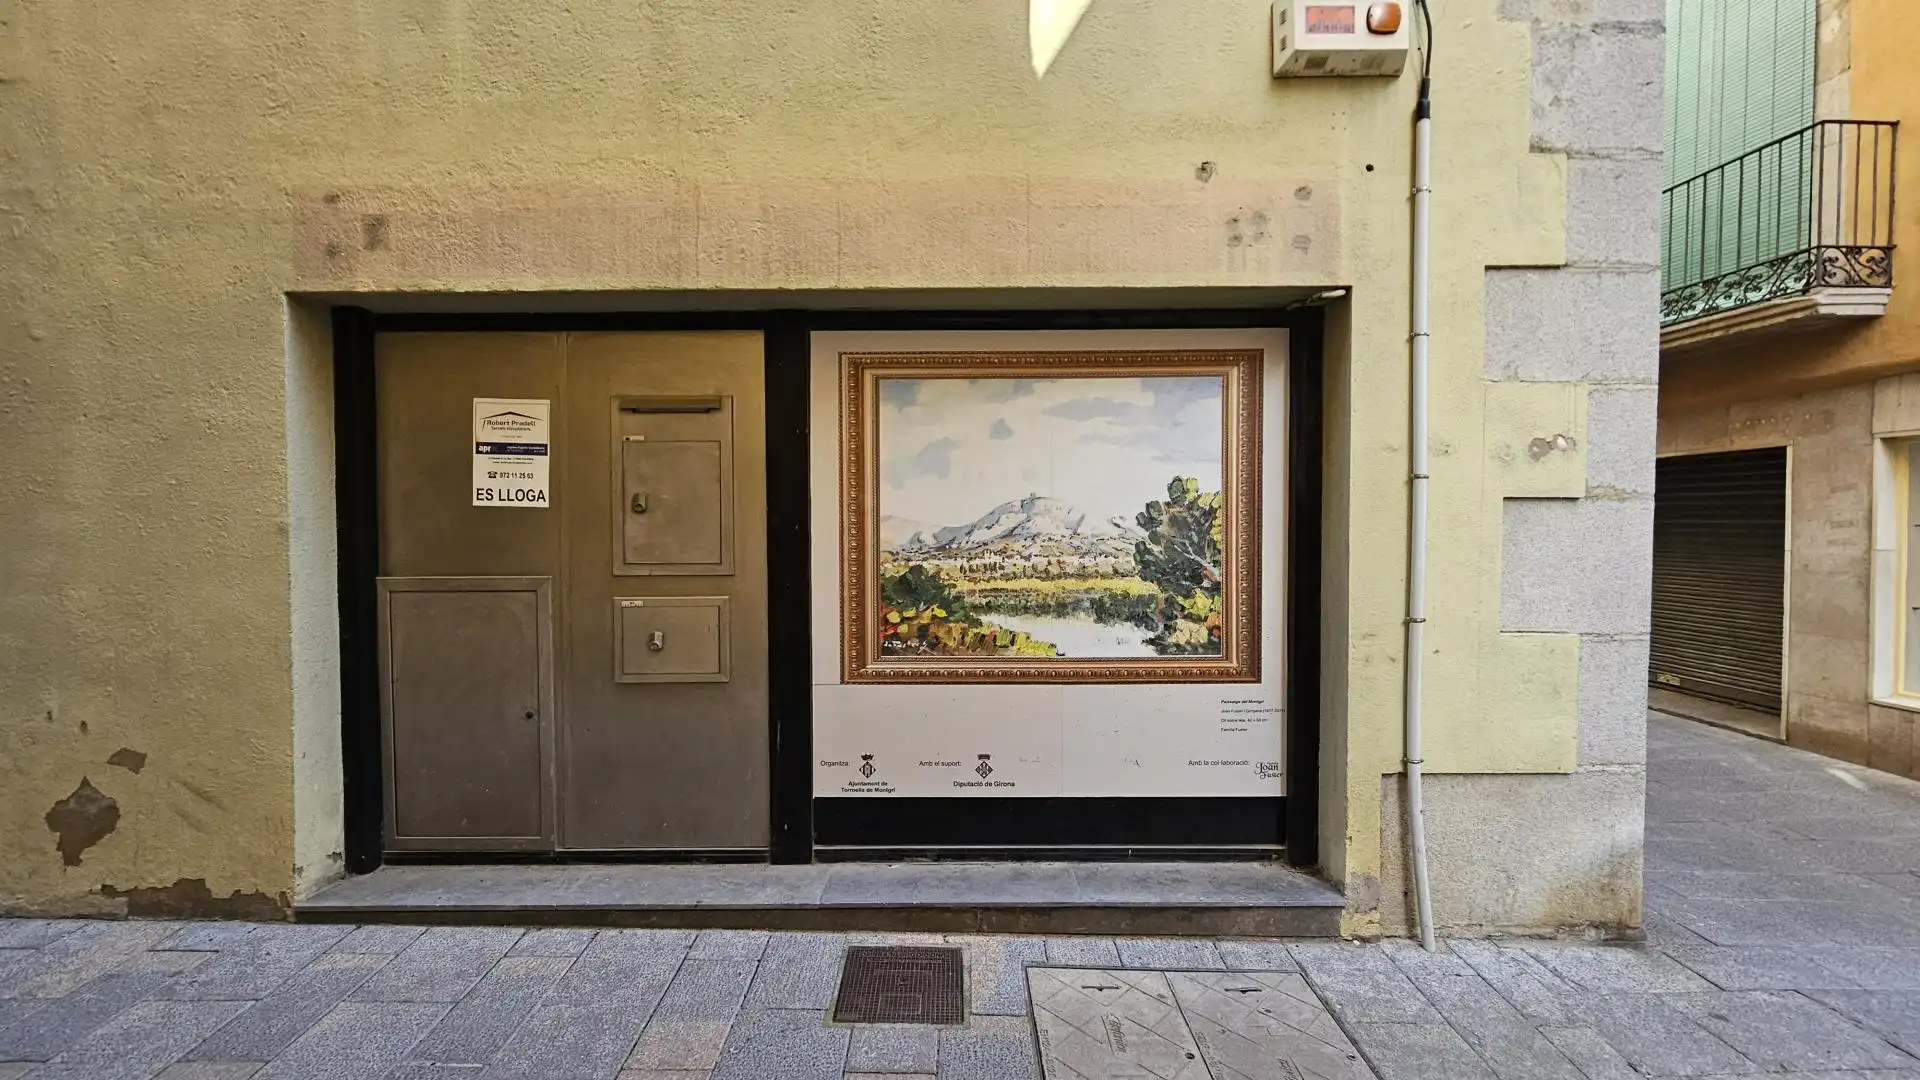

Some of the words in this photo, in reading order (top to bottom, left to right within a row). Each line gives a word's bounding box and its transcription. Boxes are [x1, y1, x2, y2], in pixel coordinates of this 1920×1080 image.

[478, 445, 492, 453] apr
[476, 488, 494, 501] ES
[498, 488, 547, 502] LLOGA
